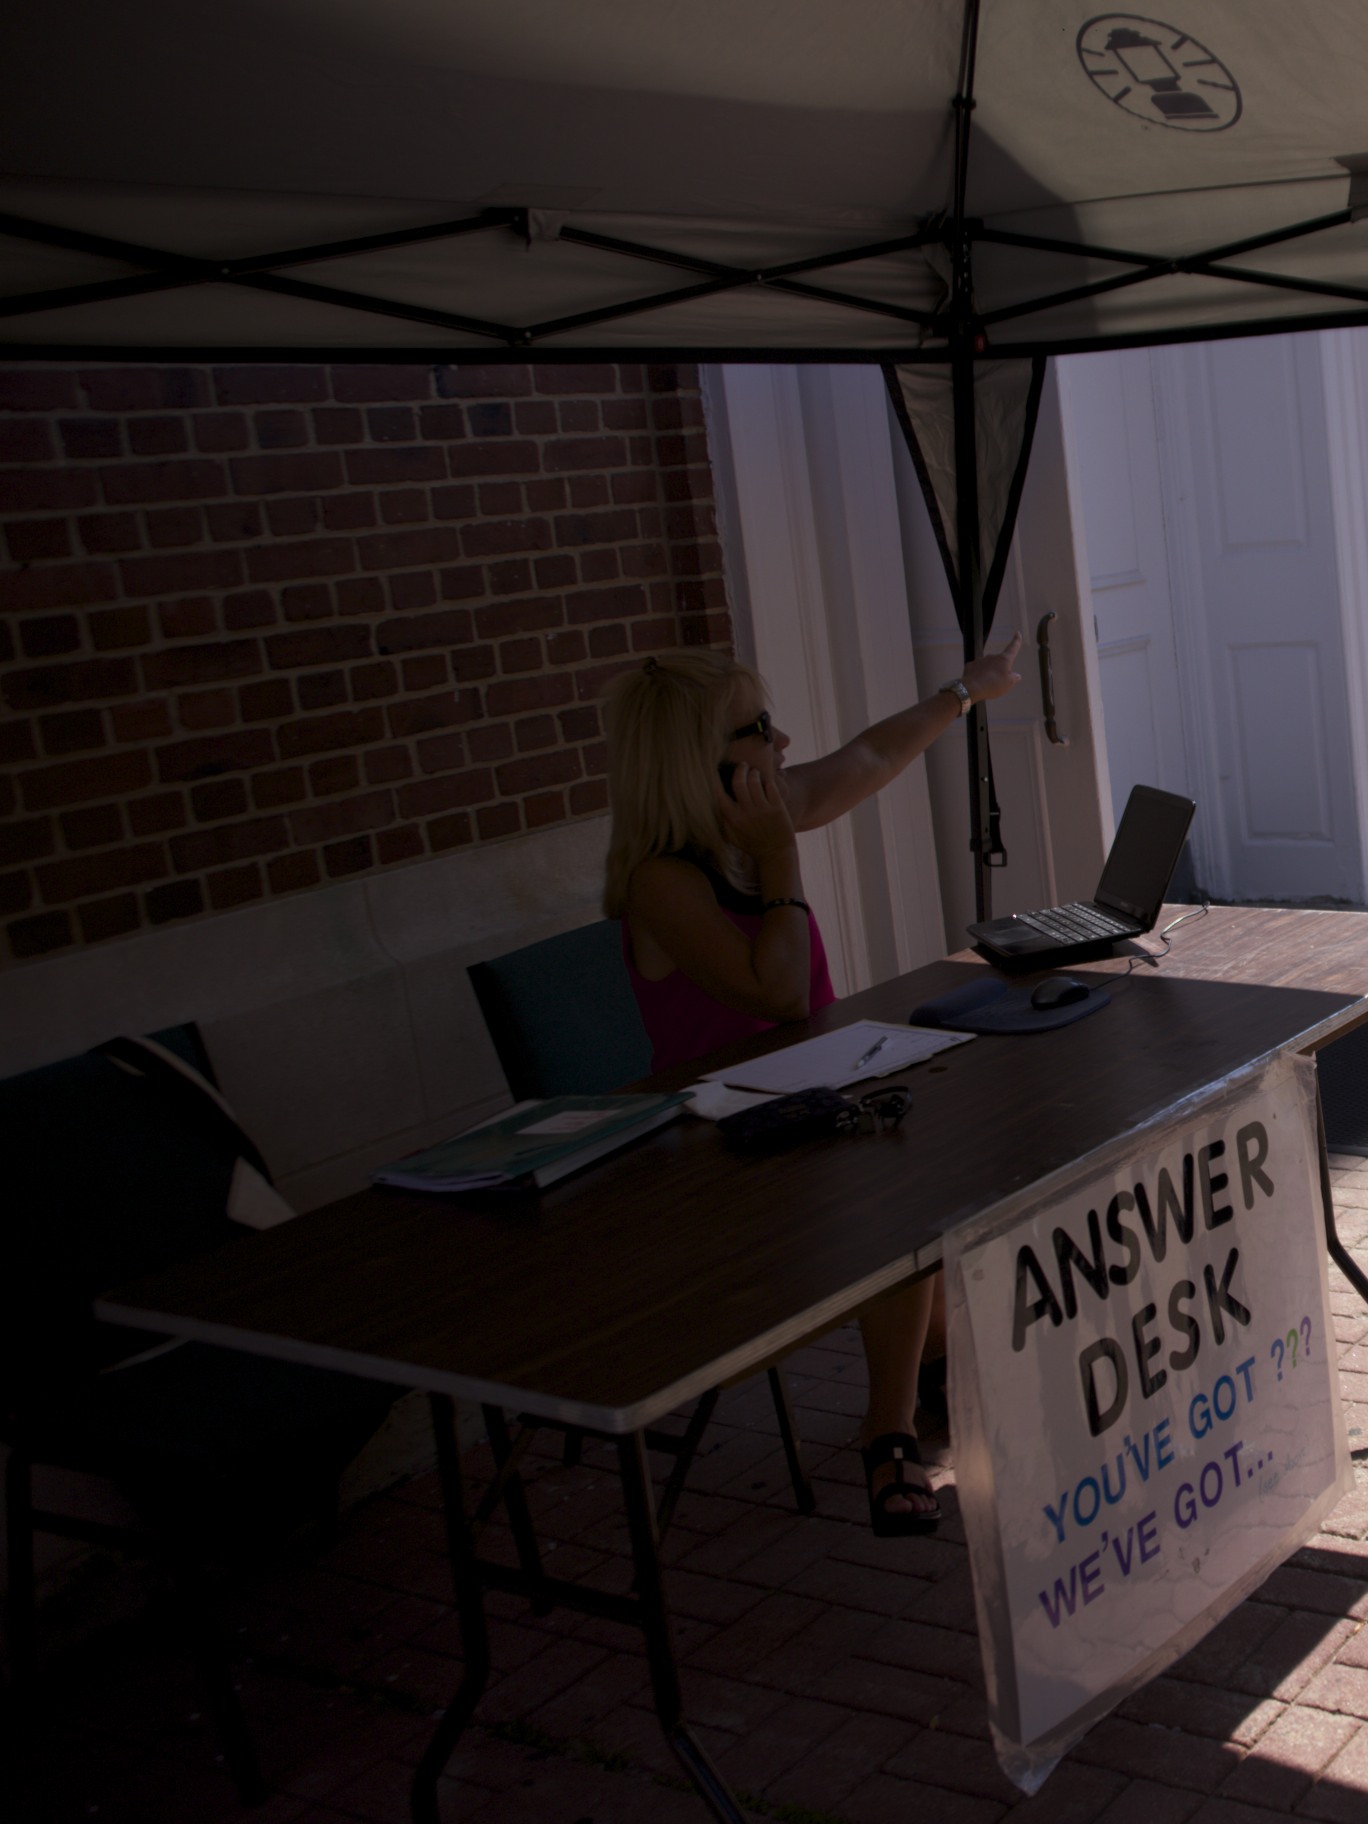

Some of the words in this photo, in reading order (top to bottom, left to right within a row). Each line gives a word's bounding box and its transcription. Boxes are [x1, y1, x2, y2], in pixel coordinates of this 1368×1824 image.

[1012, 1120, 1274, 1352] ANSWER
[1043, 1417, 1175, 1544] YOU'VE
[1188, 1357, 1257, 1440] GOT
[1270, 1315, 1313, 1382] ???
[1079, 1247, 1251, 1437] DESK
[1037, 1511, 1161, 1630] WE'VE
[1173, 1441, 1274, 1529] GOT...
